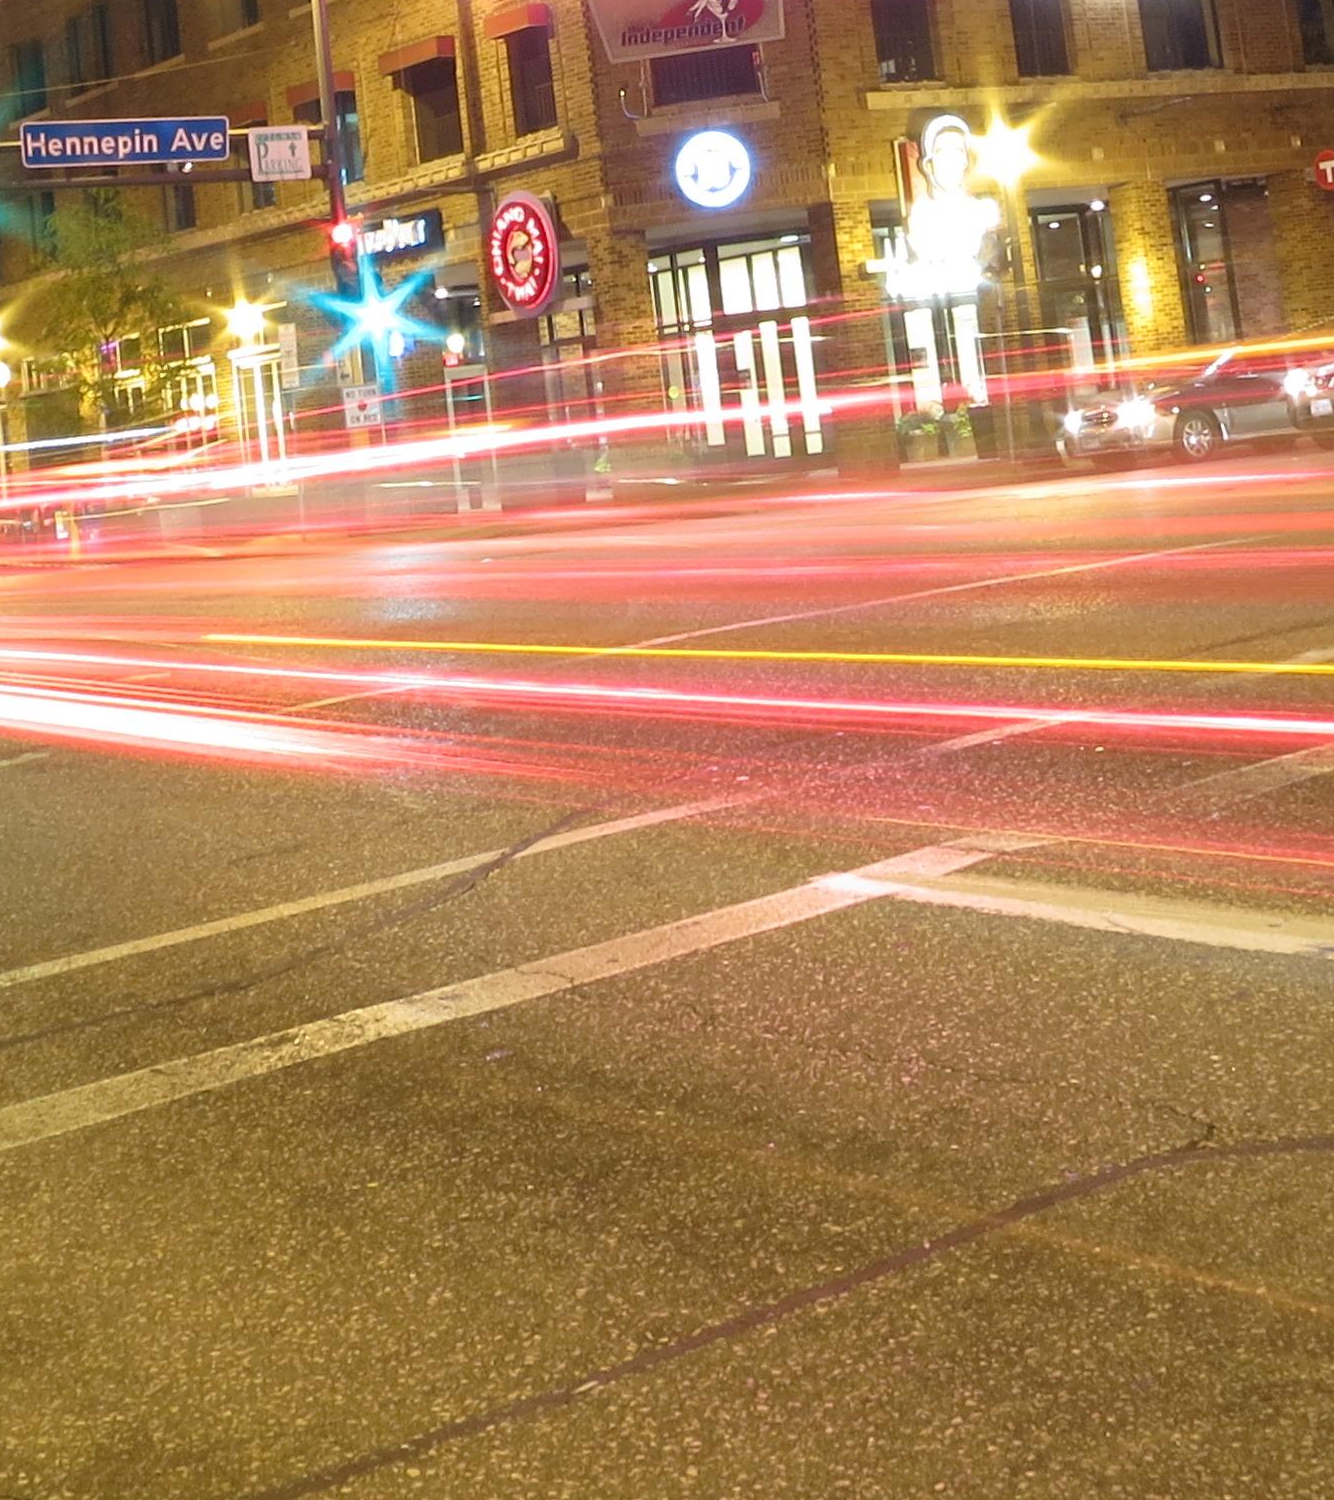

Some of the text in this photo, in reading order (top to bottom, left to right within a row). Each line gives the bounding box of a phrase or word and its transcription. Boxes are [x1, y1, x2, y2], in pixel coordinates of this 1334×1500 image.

[25, 127, 225, 158] Hennepin Ave
[491, 205, 526, 277] CHIANG
